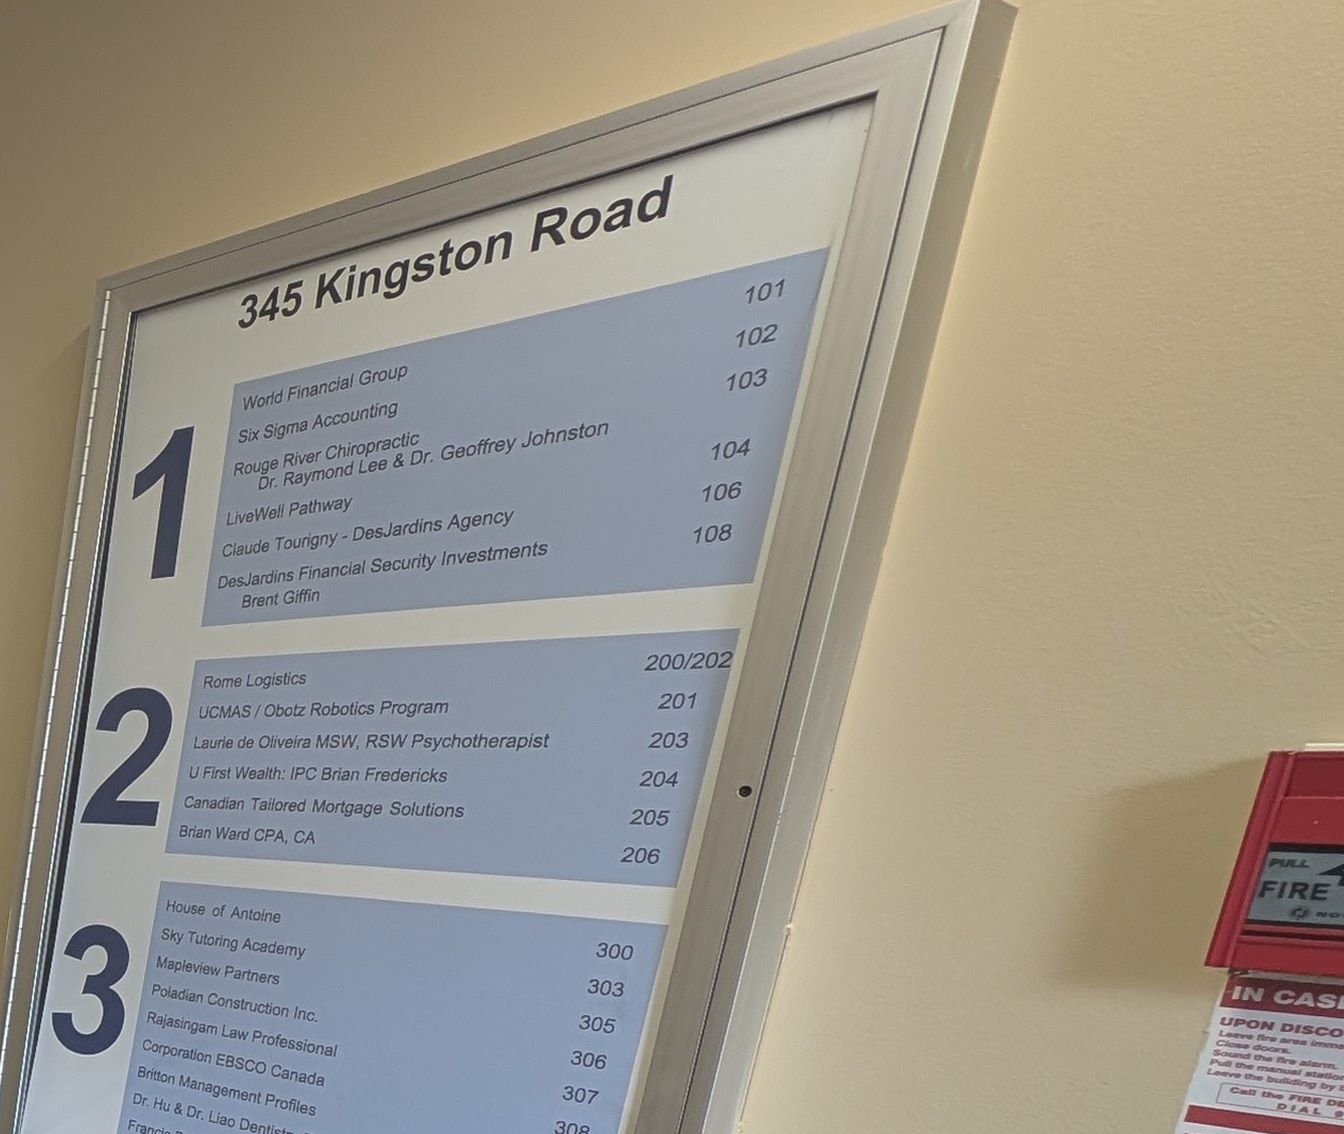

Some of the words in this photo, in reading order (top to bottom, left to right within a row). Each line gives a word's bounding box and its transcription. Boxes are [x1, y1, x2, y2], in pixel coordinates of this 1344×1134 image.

[238, 280, 303, 329] 345
[314, 230, 512, 309] Kingston
[531, 175, 674, 253] Road
[746, 278, 786, 304] 101
[736, 324, 778, 348] 102
[242, 388, 284, 411] World
[287, 373, 354, 402] Financial
[358, 366, 408, 386] Group
[726, 368, 768, 392] 103
[238, 428, 260, 444] Six
[263, 420, 308, 440] Sigma
[312, 402, 398, 430] Accounting
[233, 458, 279, 477] Rouge
[282, 450, 322, 468] River
[325, 432, 420, 460] Chiropractic
[258, 476, 278, 491] Dr.
[283, 460, 354, 487] Raymond
[358, 458, 388, 474] Lee
[392, 452, 404, 468] &
[410, 450, 434, 466] Dr.
[440, 438, 518, 461] Geoffrey
[521, 422, 609, 448] Johnston
[712, 438, 751, 461] 104
[131, 425, 196, 580] 1
[702, 481, 742, 502] 106
[226, 504, 285, 526] LiveWell
[288, 496, 354, 517] Pathway
[222, 539, 270, 558] Claude
[275, 532, 338, 551] Tourigny
[352, 518, 442, 542] DesJardins
[446, 510, 515, 532] Agency
[693, 524, 732, 544] 108
[217, 569, 294, 590] DesJardins
[298, 560, 366, 580] Financial
[370, 553, 437, 573] Security
[441, 541, 548, 566] Investments
[241, 592, 279, 608] Brent
[283, 588, 320, 605] Giffin
[644, 650, 734, 672] 200/202
[202, 676, 242, 689] Rome
[246, 671, 307, 690] Logistics
[199, 704, 252, 720] UCMAS
[254, 704, 262, 718] /
[310, 700, 375, 716] Robotics
[379, 700, 449, 718] Program
[657, 692, 697, 710] 201
[193, 736, 234, 750] Laurie
[237, 736, 254, 749] de
[258, 734, 311, 749] Oliveira
[315, 734, 360, 750] MSW,
[365, 734, 408, 748] RSW
[410, 732, 550, 752] Psychotherapist
[648, 732, 689, 748] 203
[81, 687, 173, 827] 2
[189, 766, 200, 779] U
[202, 766, 232, 780] First
[235, 766, 286, 780] Wealth:
[290, 766, 318, 781] IPC
[320, 766, 360, 782] Brian
[364, 767, 448, 783] Fredericks
[638, 770, 678, 788] 204
[184, 795, 244, 810] Canadian
[251, 797, 307, 812] Tailored
[312, 798, 383, 818] Mortgage
[389, 801, 465, 818] Solutions
[628, 808, 670, 826] 205
[178, 824, 212, 839] Brian
[216, 826, 250, 841] Ward
[254, 828, 288, 846] CPA,
[294, 830, 316, 845] CA
[620, 846, 661, 864] 206
[1269, 858, 1310, 868] PULL
[1258, 880, 1331, 901] FIRE
[166, 899, 206, 916] House
[212, 904, 226, 917] of
[230, 906, 282, 924] Antoine
[160, 928, 184, 945] Sky
[188, 930, 238, 952] Tutoring
[242, 938, 306, 960] Academy
[596, 942, 634, 961] 300
[156, 955, 222, 976] Mapleview
[224, 965, 280, 985] Partners
[51, 924, 130, 1056] 3
[587, 978, 624, 998] 303
[1231, 985, 1265, 1001] IN
[1273, 989, 1344, 1010] CAS
[152, 984, 204, 1003] Poladian
[208, 992, 290, 1018] Construction
[293, 1006, 318, 1023] Inc.
[146, 1011, 218, 1036] Rajasingam
[221, 1024, 250, 1041] Law
[252, 1030, 338, 1058] Professional
[578, 1014, 616, 1034] 305
[1219, 1016, 1276, 1031] UPON
[142, 1038, 212, 1064] Corporation
[216, 1053, 266, 1074] EBSCO
[270, 1064, 325, 1087] Canada
[570, 1050, 608, 1070] 306
[137, 1066, 176, 1085] Britton
[178, 1074, 262, 1104] Management
[264, 1093, 317, 1116] Profiles
[562, 1086, 600, 1104] 307
[132, 1092, 149, 1107] Dr.
[152, 1096, 171, 1112] Hu
[174, 1102, 183, 1116] &
[186, 1105, 204, 1120] Dr.
[208, 1110, 236, 1128] Liao
